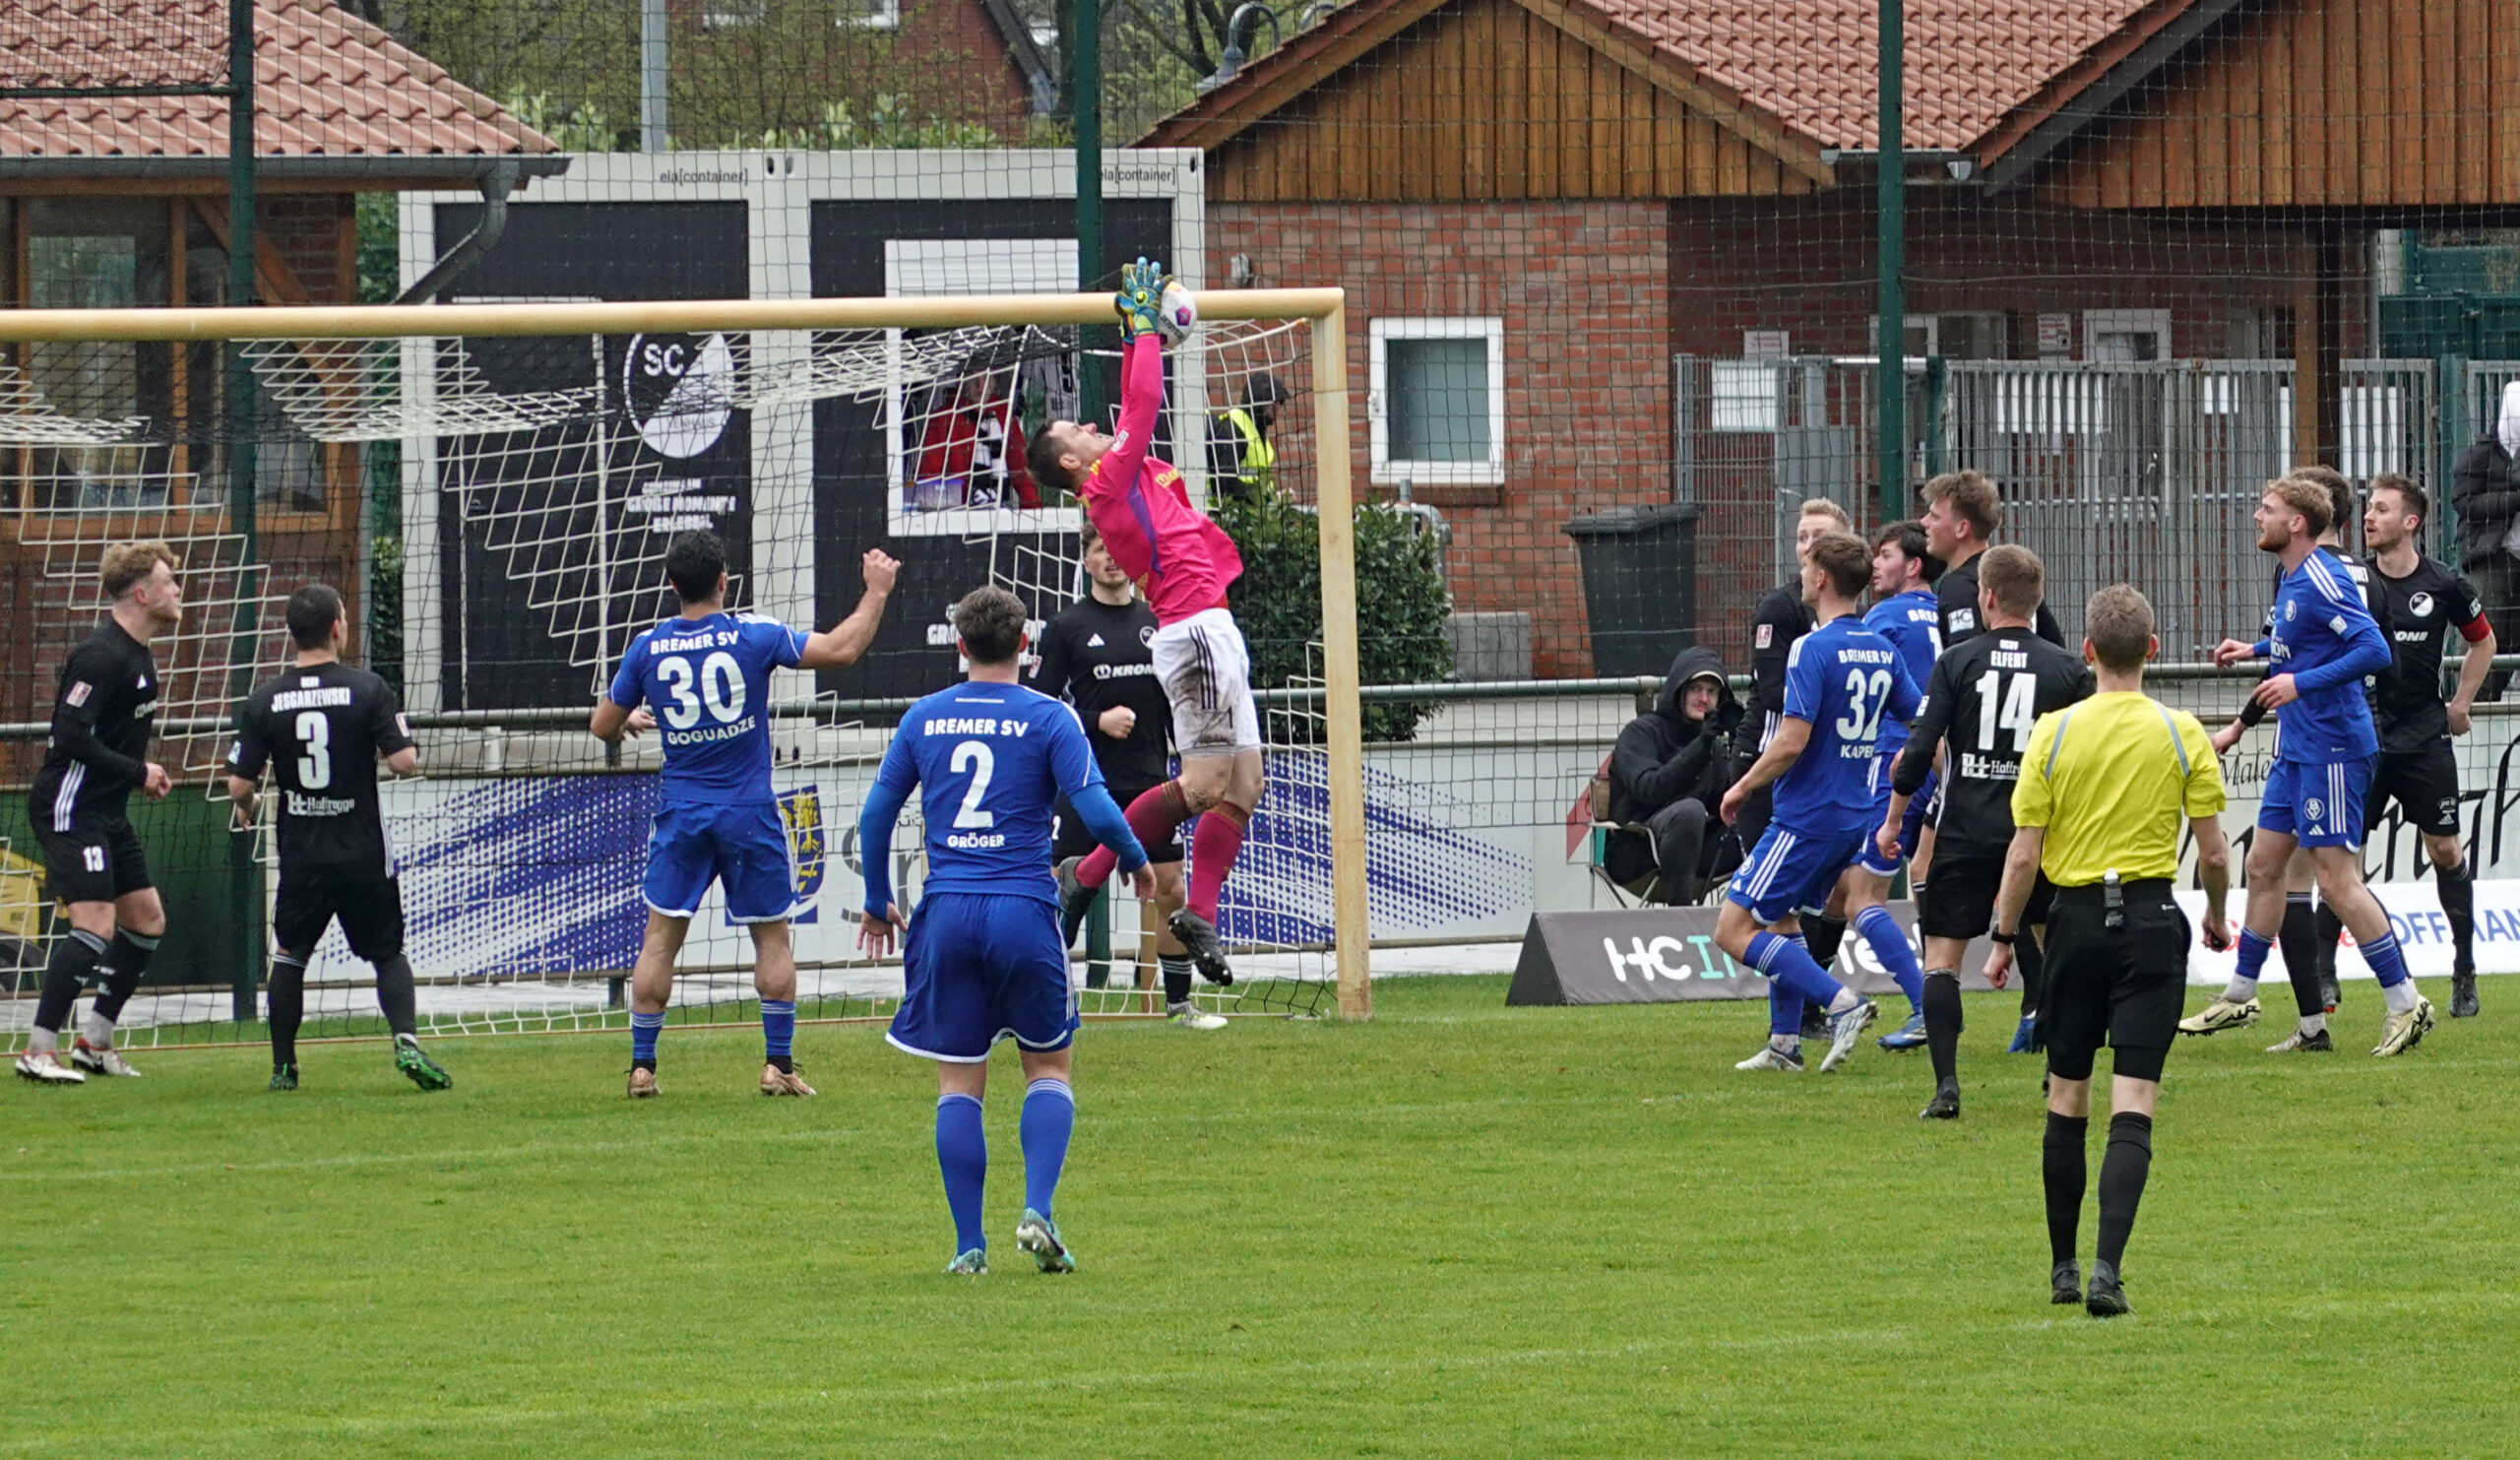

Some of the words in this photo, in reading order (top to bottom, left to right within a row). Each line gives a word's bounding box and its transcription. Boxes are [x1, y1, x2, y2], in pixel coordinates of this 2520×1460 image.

[660, 167, 748, 187] ela[container]
[1102, 165, 1176, 186] la[container]
[643, 343, 685, 377] SC
[650, 634, 714, 656] BREMER
[716, 630, 738, 647] SV
[2394, 630, 2428, 643] ONE
[1838, 649, 1880, 664] BREMER
[1880, 651, 1894, 665] SV
[1990, 651, 2028, 668] ELFERT
[271, 687, 350, 713] JESGARZEWSKI
[658, 651, 746, 730] 30
[1836, 667, 1892, 741] 32
[1976, 669, 2036, 753] 14
[666, 715, 756, 745] GOGUADZE
[924, 719, 996, 736] BREMER
[1000, 720, 1029, 737] SV
[295, 711, 331, 790] 3
[950, 739, 994, 828] 2
[947, 832, 1005, 849] GRÖGER
[83, 845, 104, 872] 13
